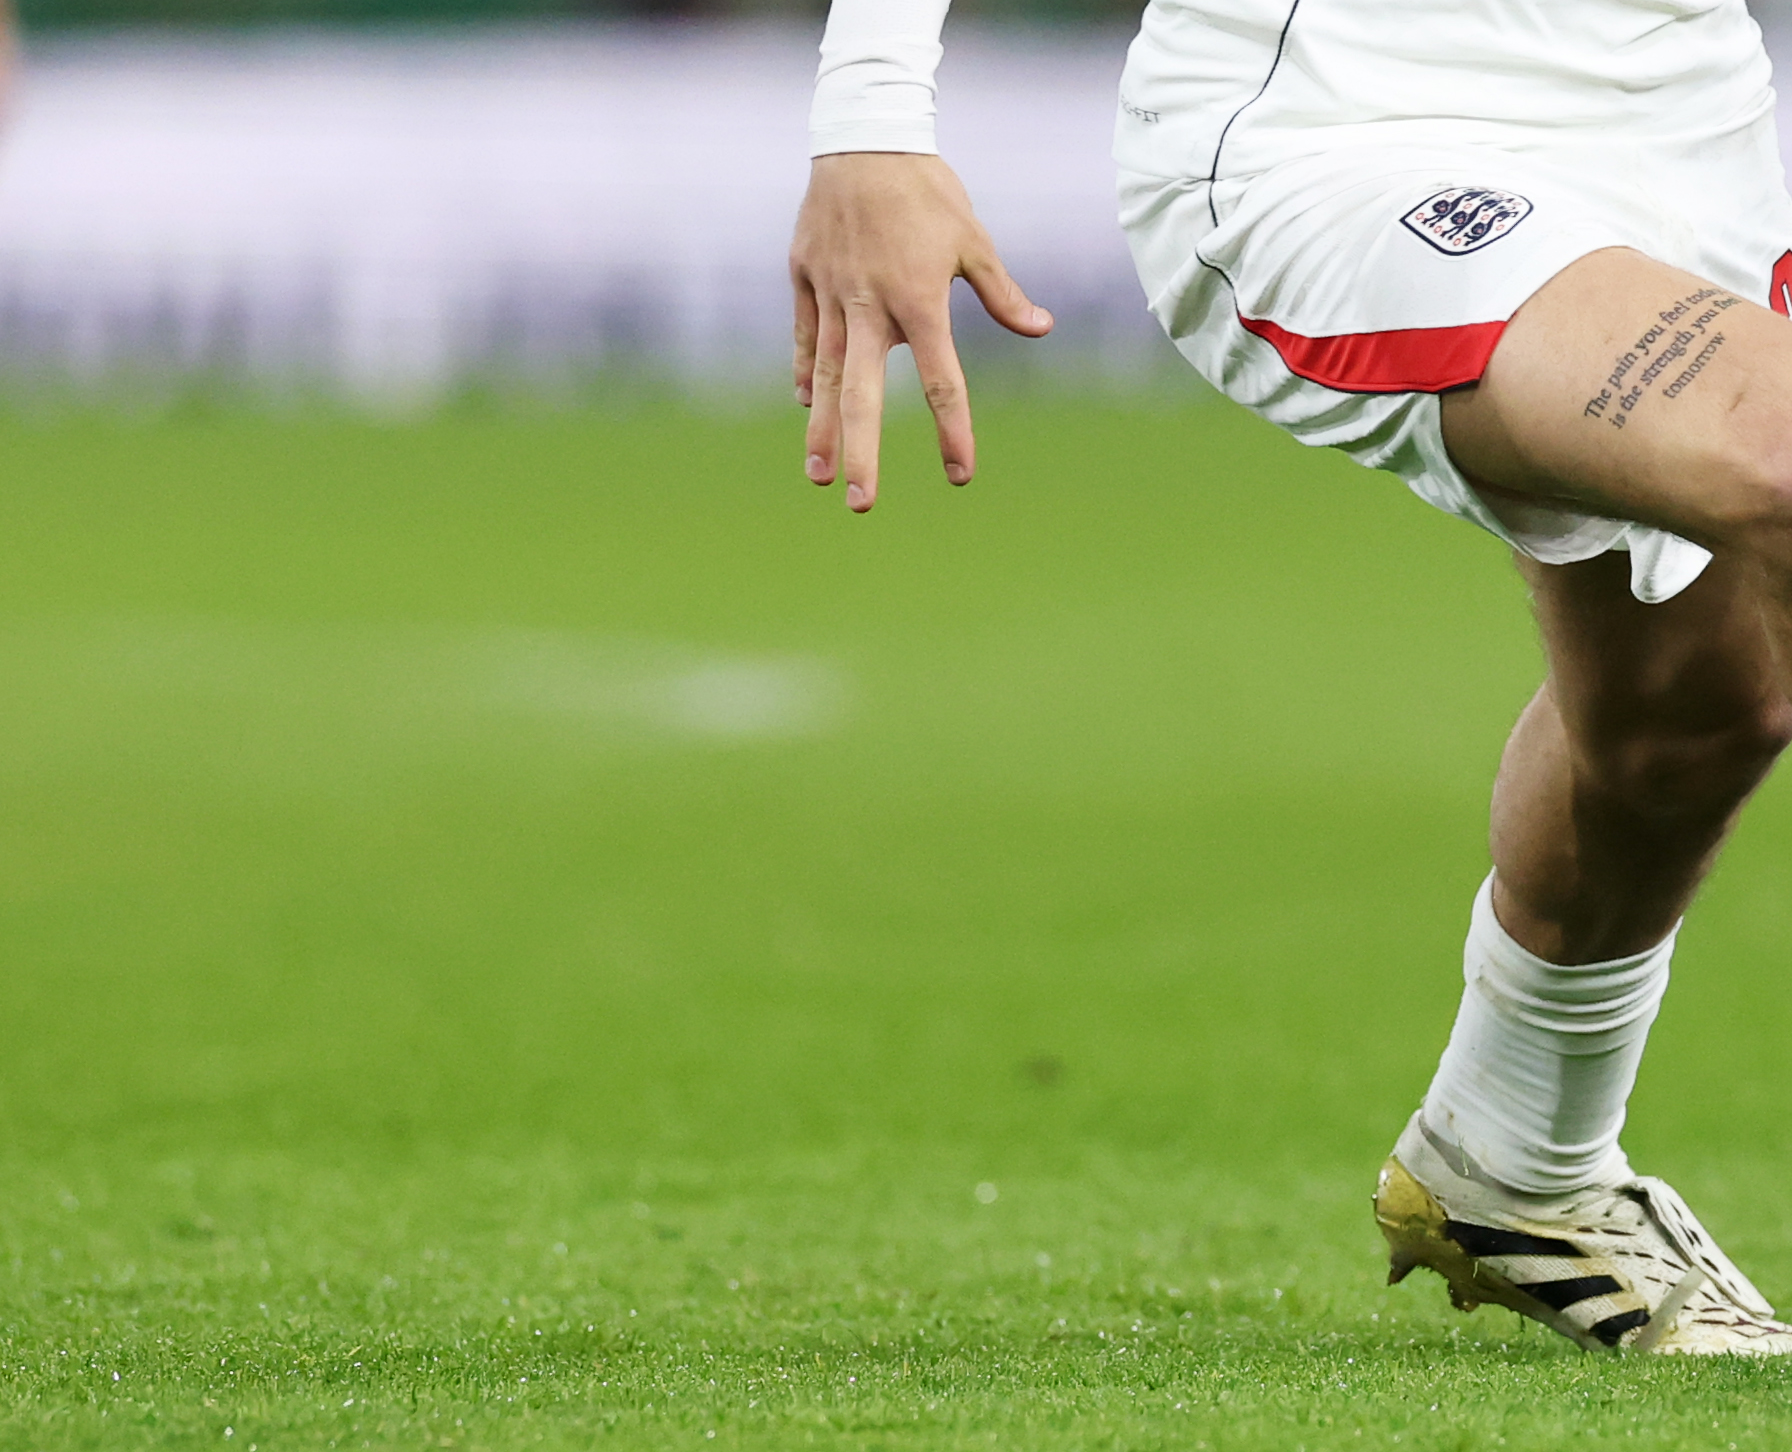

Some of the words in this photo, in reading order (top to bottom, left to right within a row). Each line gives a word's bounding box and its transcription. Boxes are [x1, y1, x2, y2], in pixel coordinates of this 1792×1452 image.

[1584, 388, 1612, 419] The
[1608, 351, 1638, 389] pain
[1635, 324, 1665, 355] you
[1658, 301, 1691, 326] feel
[1609, 413, 1626, 430] is
[1620, 384, 1643, 412] the
[1640, 330, 1695, 387] strength
[1690, 307, 1718, 335] you
[1661, 331, 1727, 400] tomorrow
